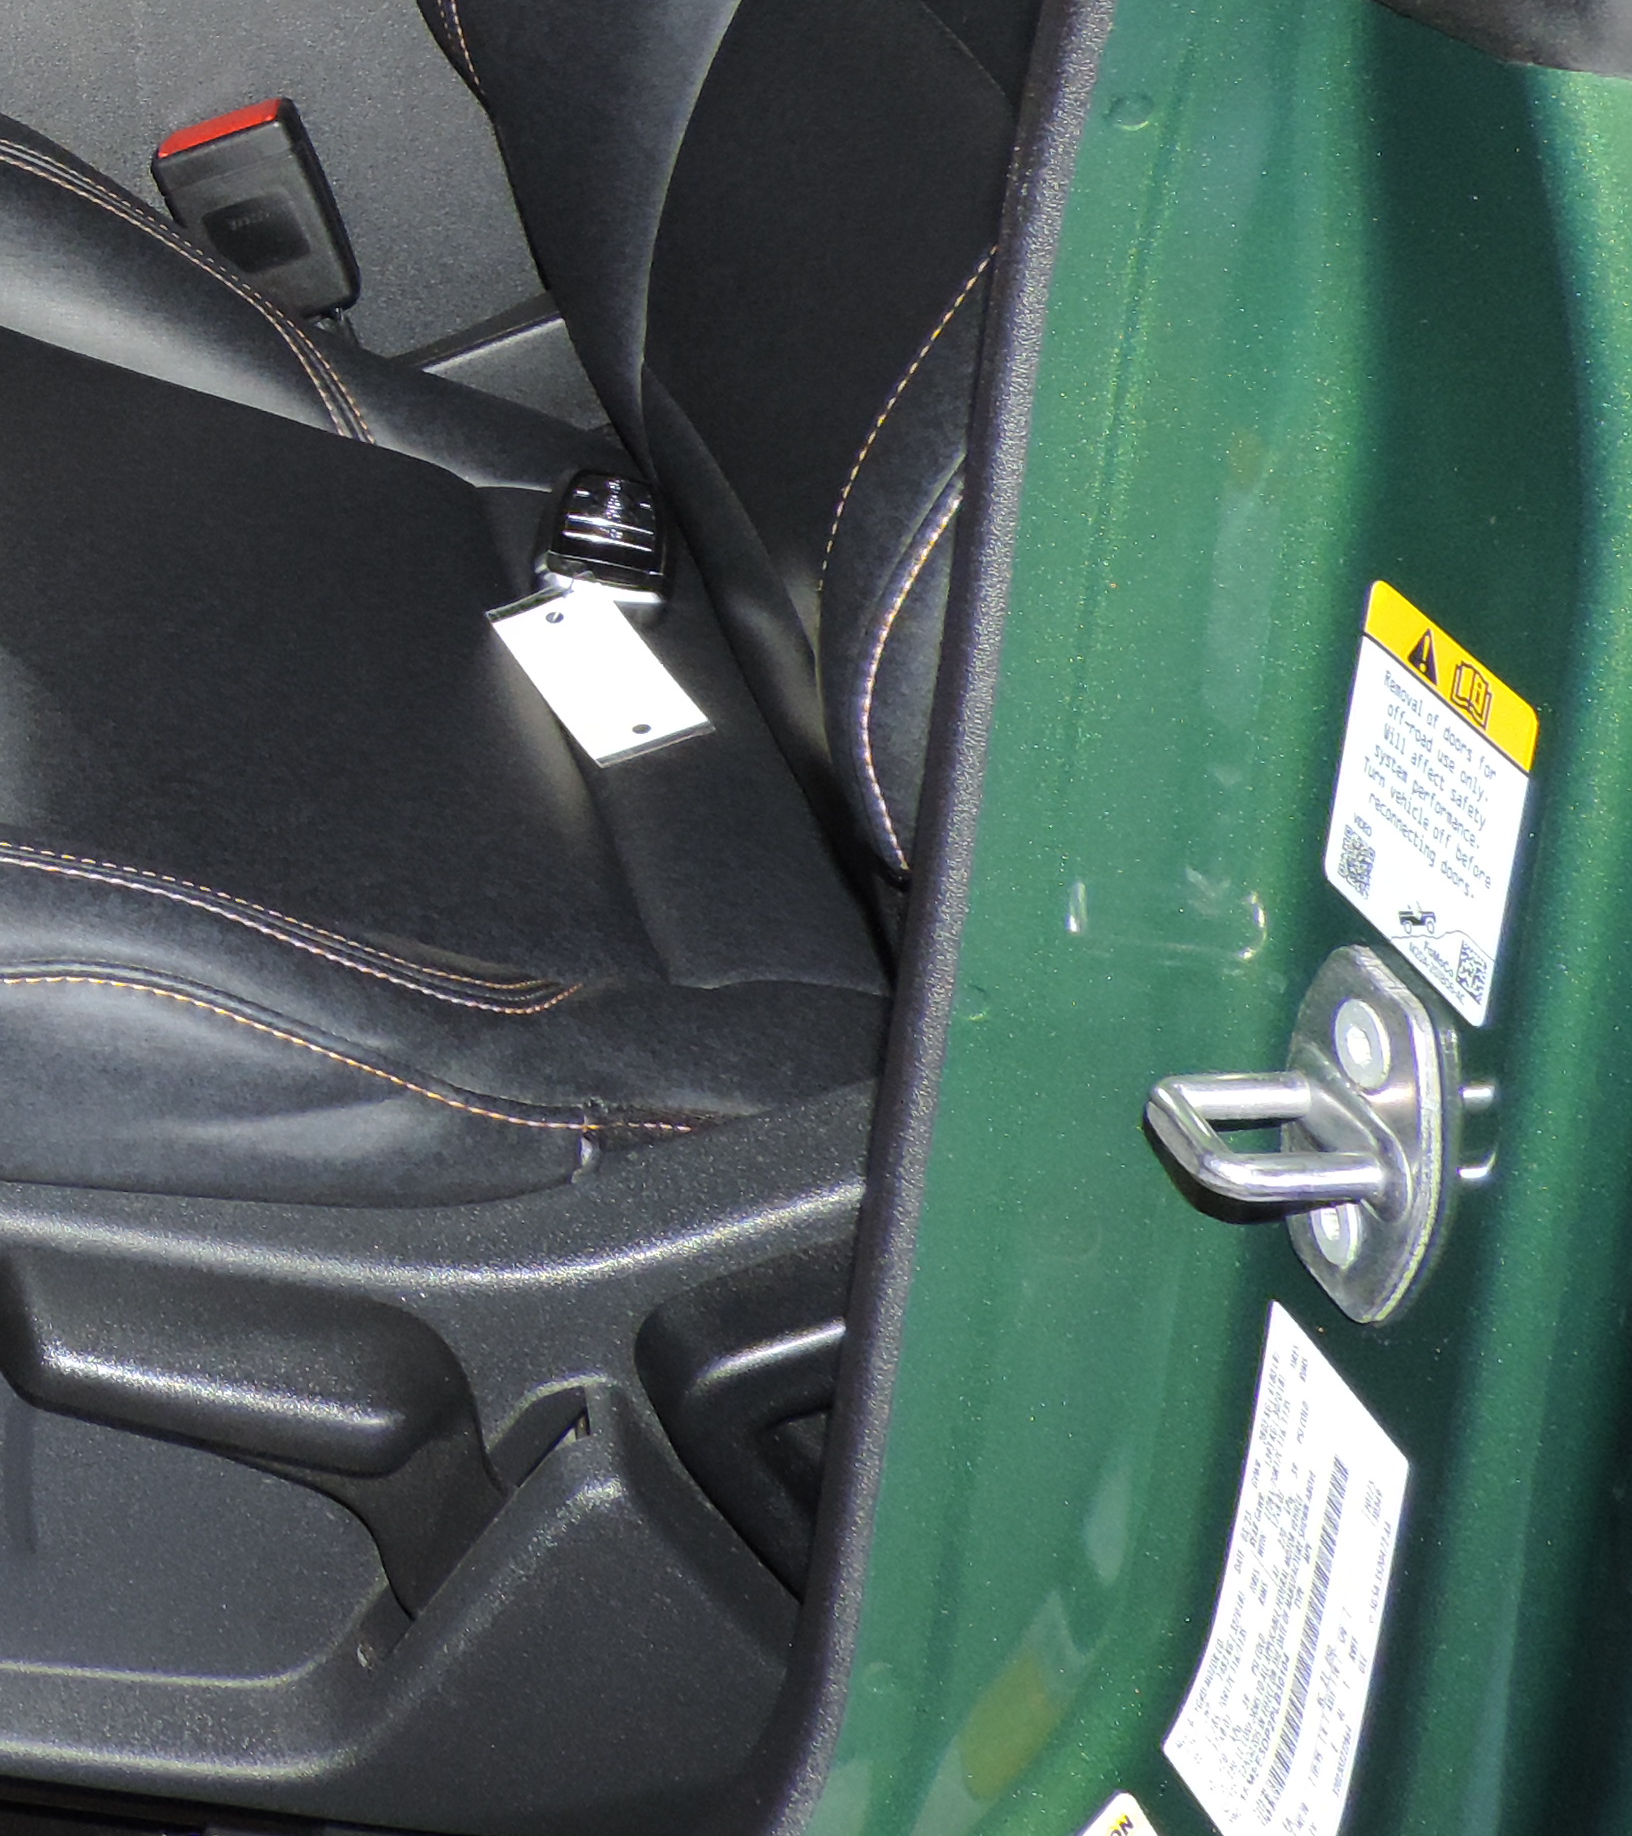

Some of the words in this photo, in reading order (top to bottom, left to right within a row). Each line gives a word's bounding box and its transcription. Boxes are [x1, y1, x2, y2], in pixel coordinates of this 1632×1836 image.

[1383, 670, 1424, 717] Removal
[1426, 713, 1440, 729] of
[1443, 726, 1473, 762] doors
[1479, 756, 1497, 781] for
[1383, 724, 1406, 755] Will
[1411, 754, 1445, 791] affect
[1450, 788, 1487, 832] safety
[1387, 703, 1433, 752] off-road
[1437, 749, 1456, 773] use
[1460, 770, 1489, 803] only.
[1364, 756, 1386, 789] Turn
[1390, 783, 1430, 830] vehicle
[1433, 824, 1451, 849] off
[1455, 842, 1492, 890] before
[1369, 792, 1437, 867] reconnecting
[1441, 859, 1476, 899] doors.
[1374, 744, 1408, 782] system
[1412, 778, 1480, 850] performance.
